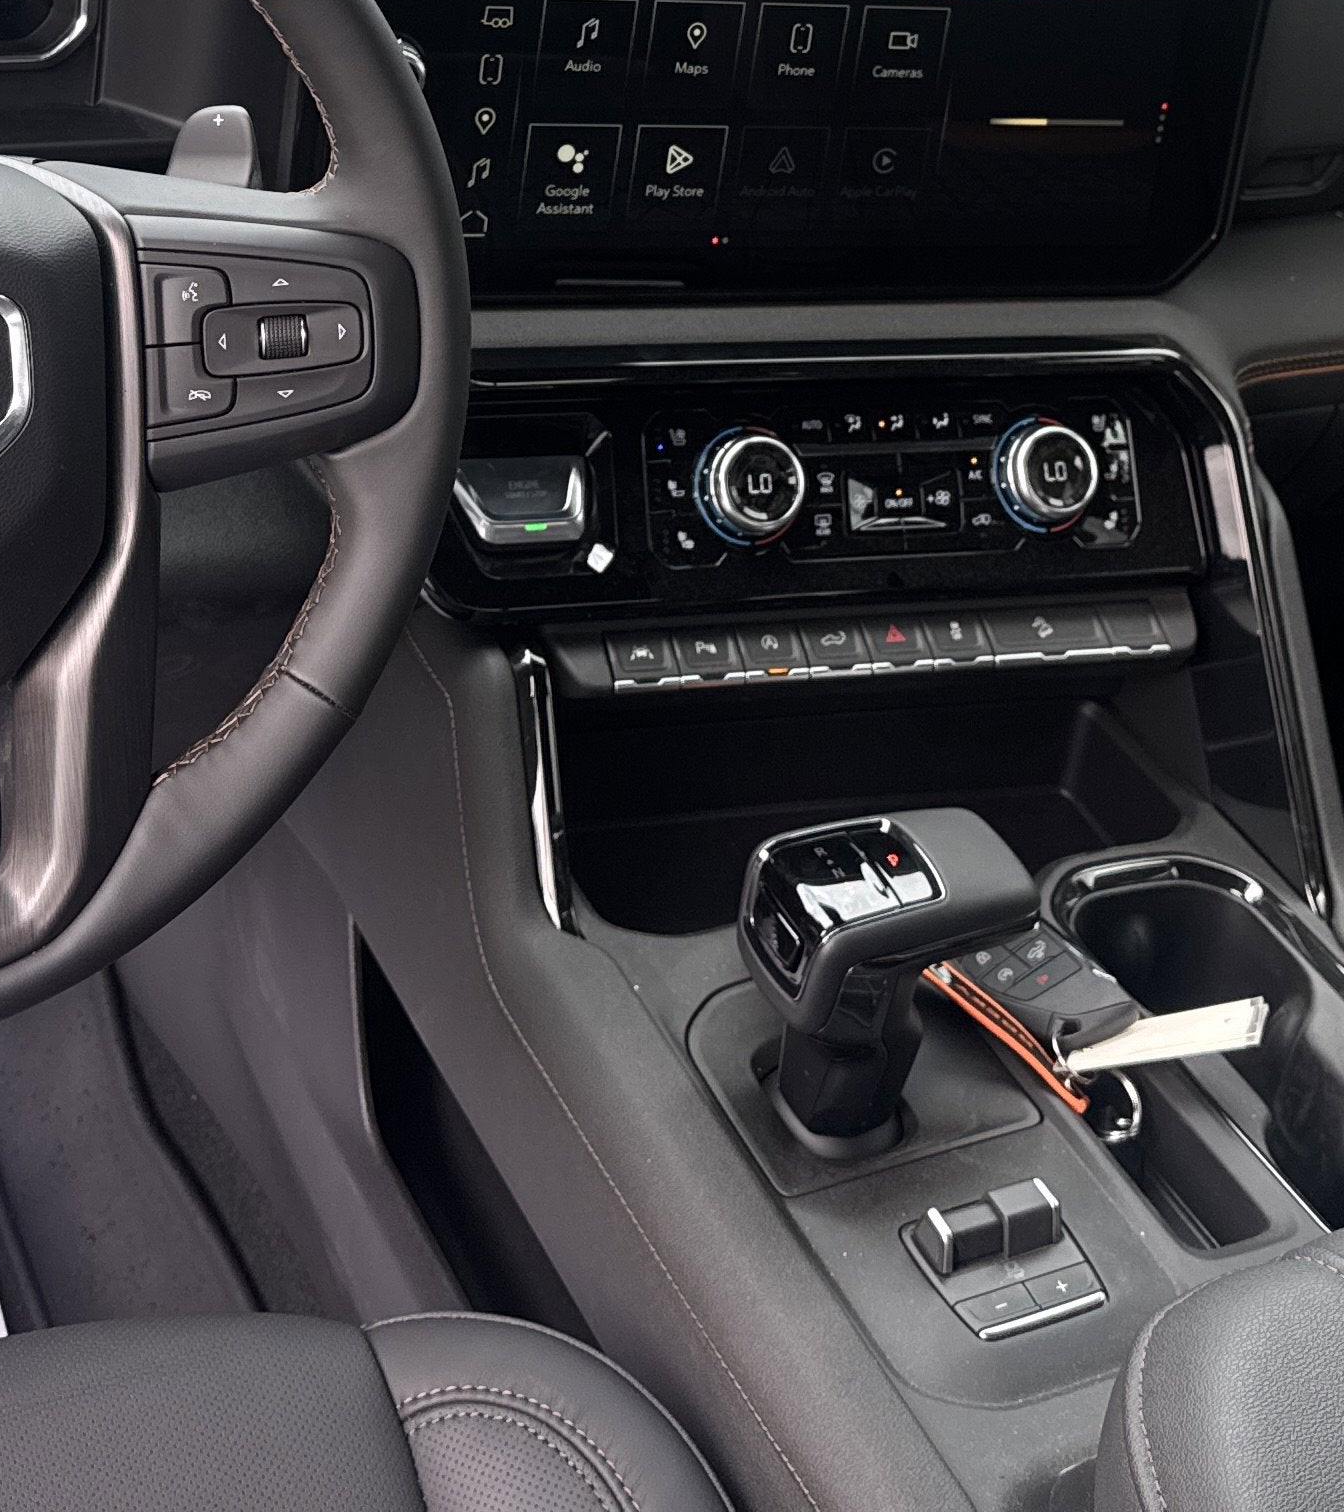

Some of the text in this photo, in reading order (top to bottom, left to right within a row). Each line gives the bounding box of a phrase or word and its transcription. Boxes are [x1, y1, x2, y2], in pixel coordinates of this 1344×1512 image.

[564, 59, 602, 74] Audio
[674, 61, 709, 77] Maps
[777, 63, 816, 77] Phone
[872, 65, 924, 80] Cameras
[545, 184, 590, 201] Google
[645, 184, 704, 200] Play Store
[536, 201, 594, 216] Assistant
[1043, 461, 1068, 483] LO
[747, 473, 773, 495] LO
